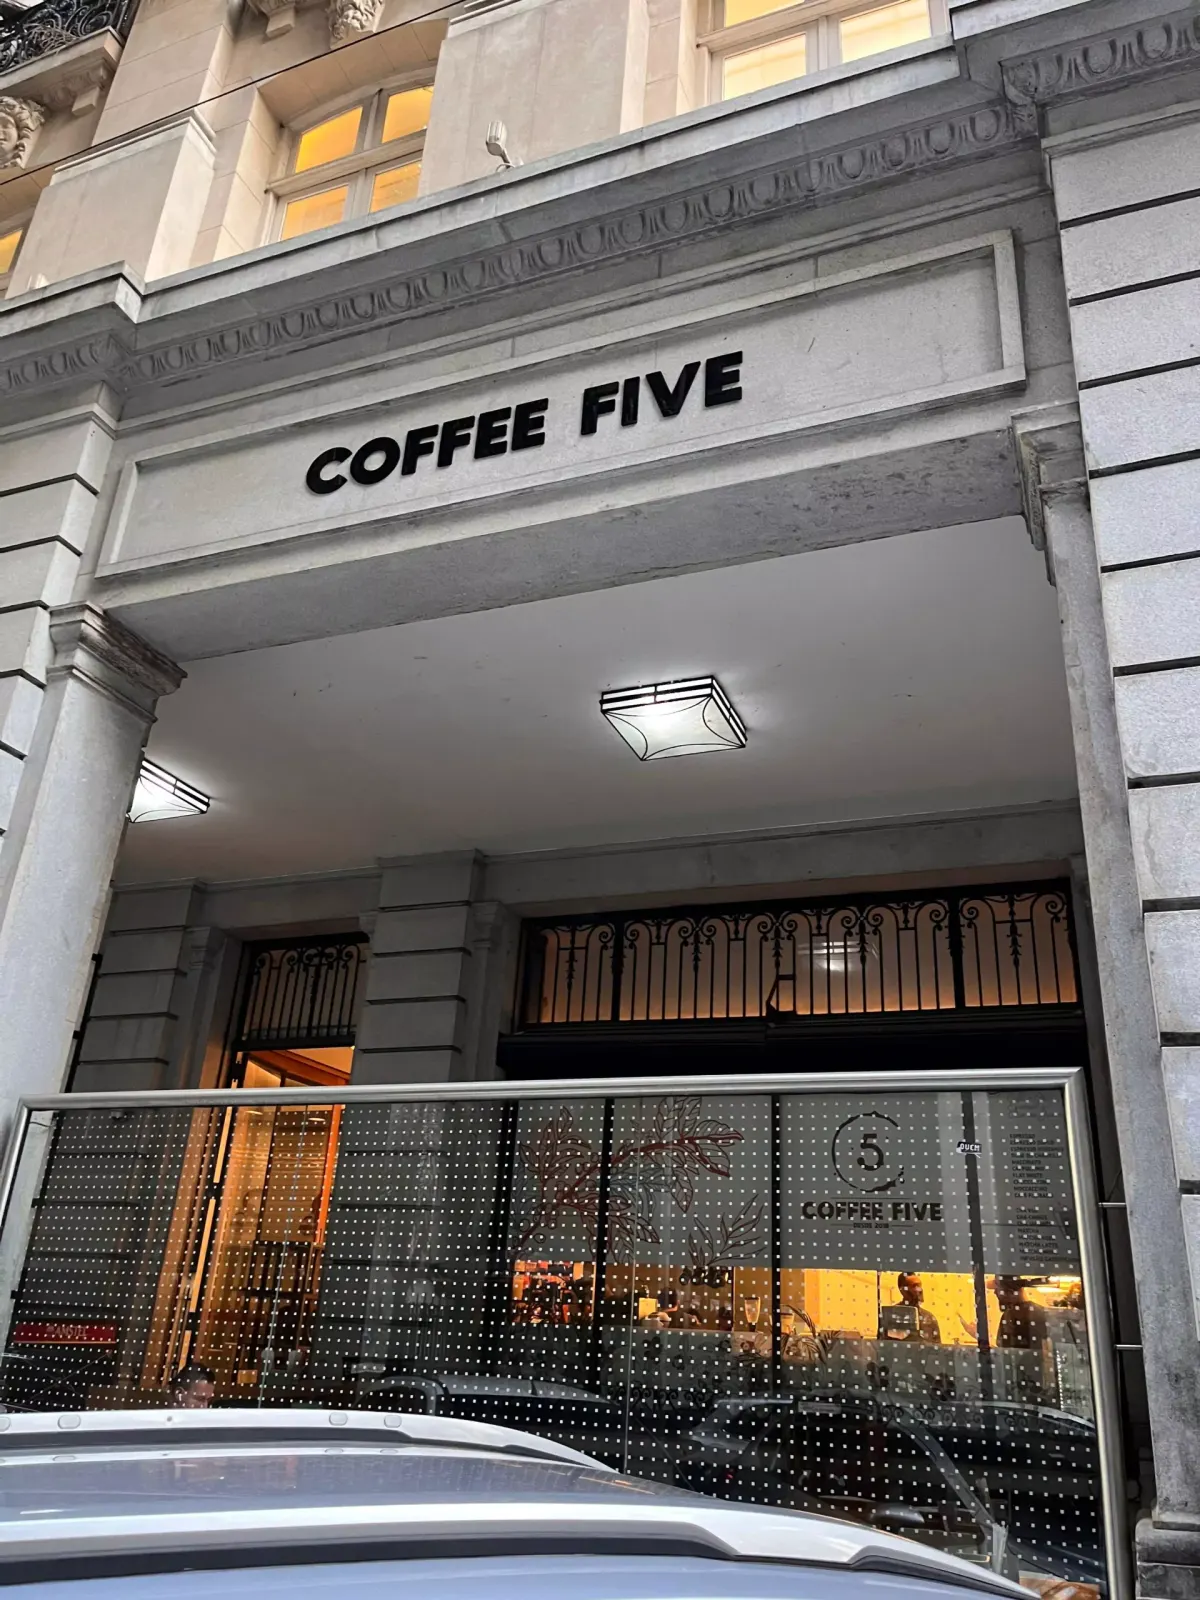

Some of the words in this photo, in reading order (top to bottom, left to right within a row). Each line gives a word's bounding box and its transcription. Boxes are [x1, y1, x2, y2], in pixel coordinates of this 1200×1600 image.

[305, 397, 549, 495] COFFEE
[580, 350, 743, 436] FIVE
[857, 1133, 884, 1171] 5
[801, 1201, 883, 1220] COFFEE
[892, 1202, 942, 1221] FIVE
[55, 1326, 87, 1337] AMSTEL
